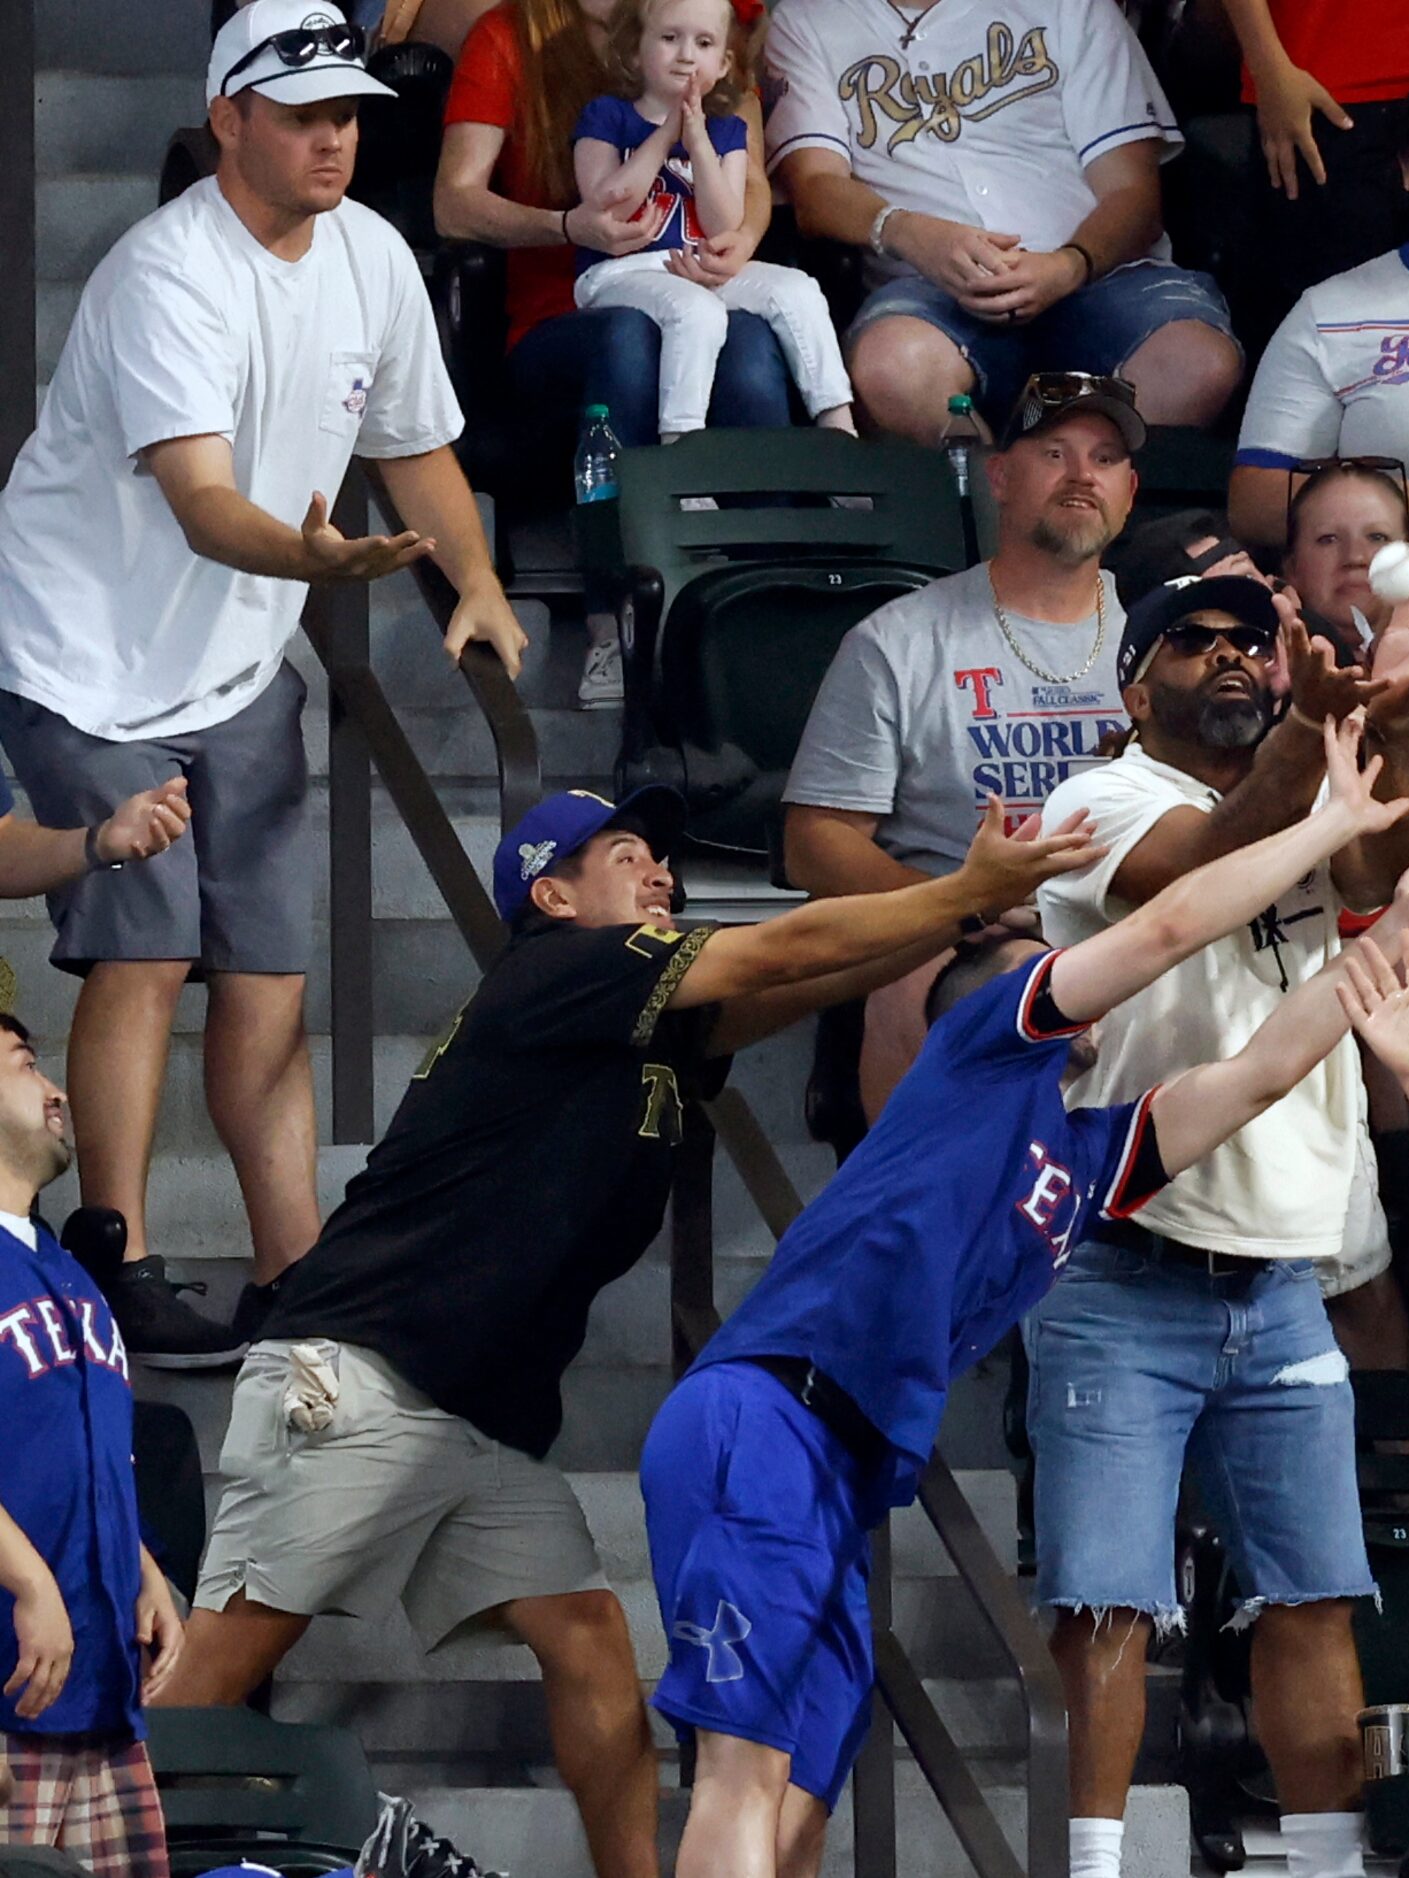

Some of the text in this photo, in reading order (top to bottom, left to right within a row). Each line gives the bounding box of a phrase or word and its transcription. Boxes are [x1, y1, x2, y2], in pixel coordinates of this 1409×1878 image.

[838, 21, 1059, 157] Royals
[828, 574, 842, 585] 23
[953, 667, 1004, 721] T
[972, 761, 1069, 800] SERI
[1392, 1528, 1407, 1540] 23
